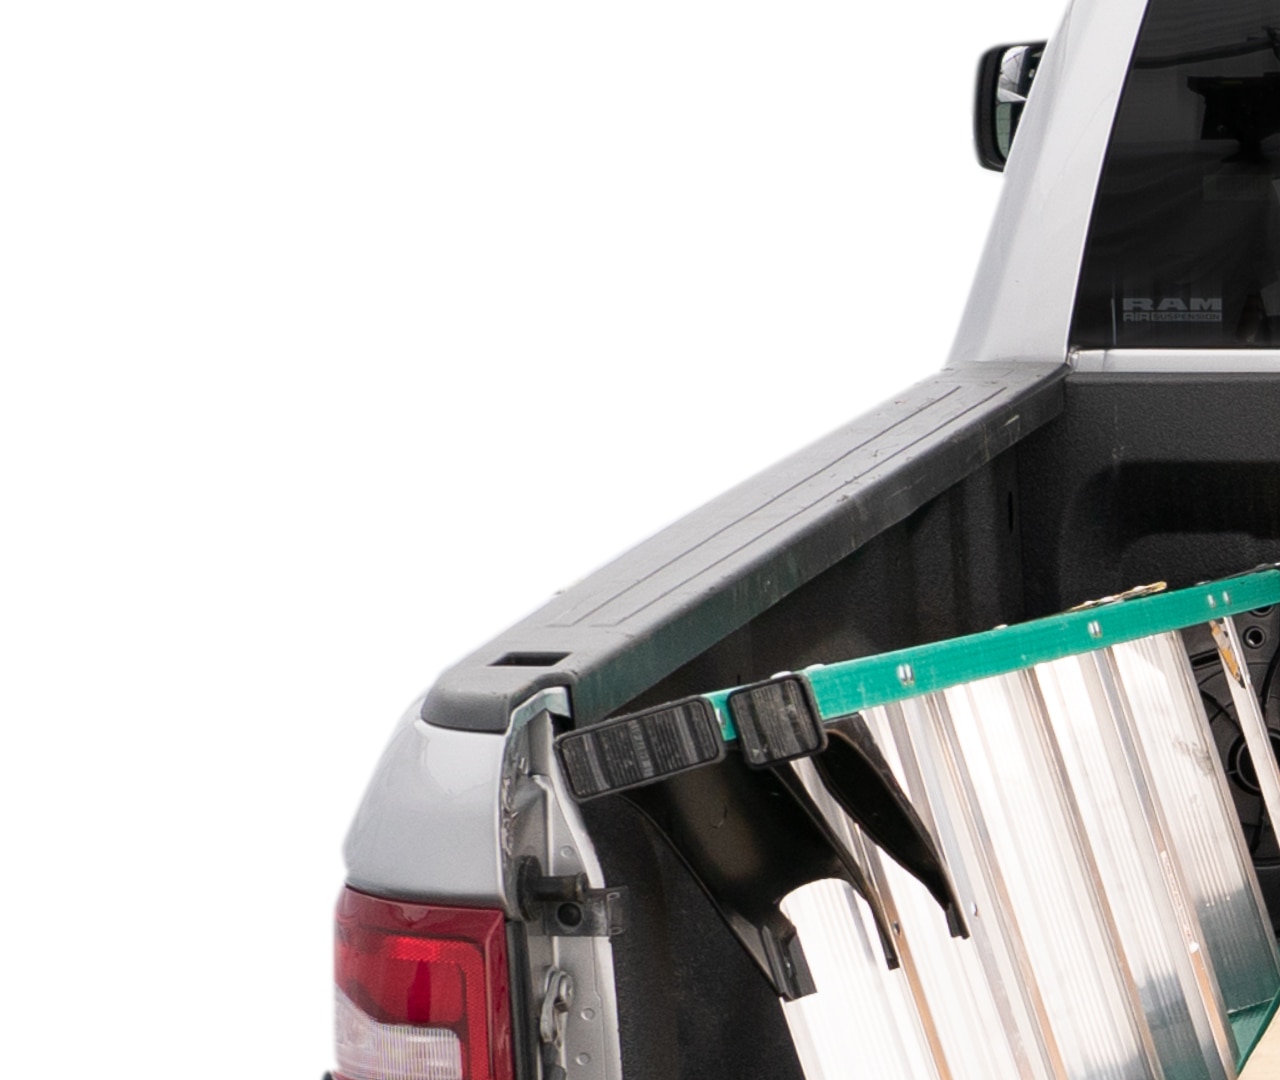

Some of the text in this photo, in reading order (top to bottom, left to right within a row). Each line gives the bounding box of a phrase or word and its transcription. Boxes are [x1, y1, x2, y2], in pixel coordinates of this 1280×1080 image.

[1122, 297, 1222, 311] RAM
[1122, 312, 1221, 322] AIR SUSPENSION
